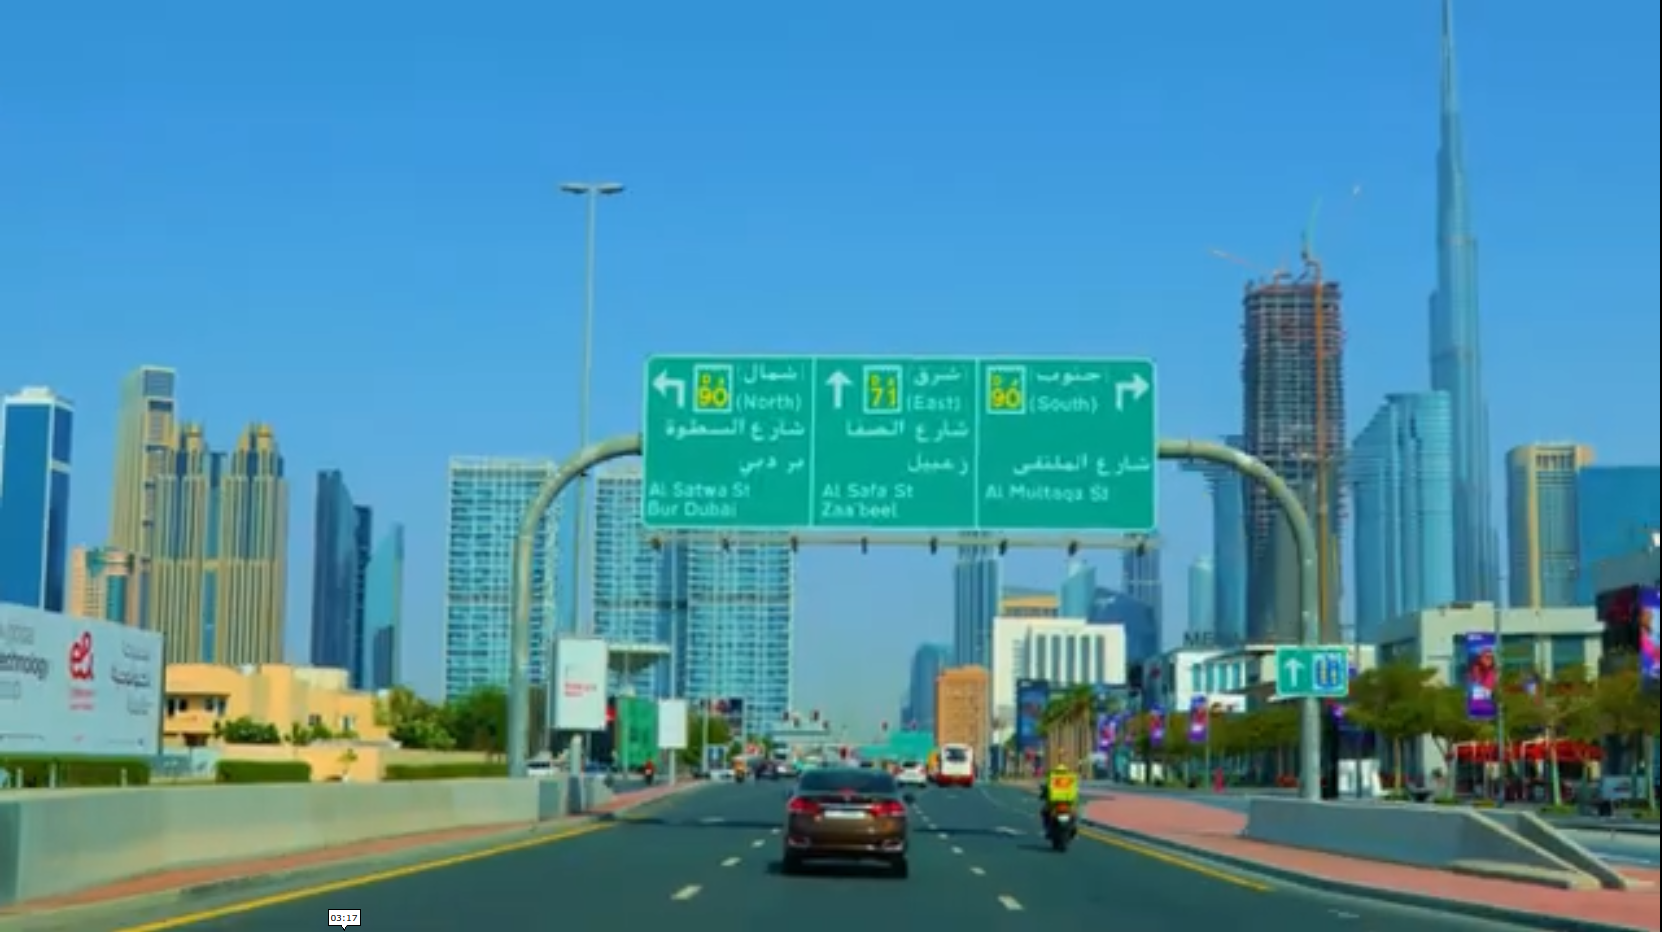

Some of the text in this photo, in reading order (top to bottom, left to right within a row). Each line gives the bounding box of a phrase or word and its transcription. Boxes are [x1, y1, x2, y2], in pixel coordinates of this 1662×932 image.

[698, 387, 729, 407] 90
[736, 393, 802, 412] (North)
[870, 387, 898, 407] 71
[907, 394, 961, 412] (East)
[991, 387, 1022, 407] 90
[1029, 395, 1099, 414] (South)
[665, 417, 805, 441] شارع السطوة
[845, 418, 970, 443] شارع الصفا
[739, 455, 777, 478] دبي
[1097, 453, 1151, 477] شارع
[673, 482, 727, 498] Satwa
[732, 482, 750, 497] St
[822, 483, 914, 498] Al Safa St
[1008, 484, 1083, 502] Multaqa
[647, 500, 738, 518] Bur Dubai
